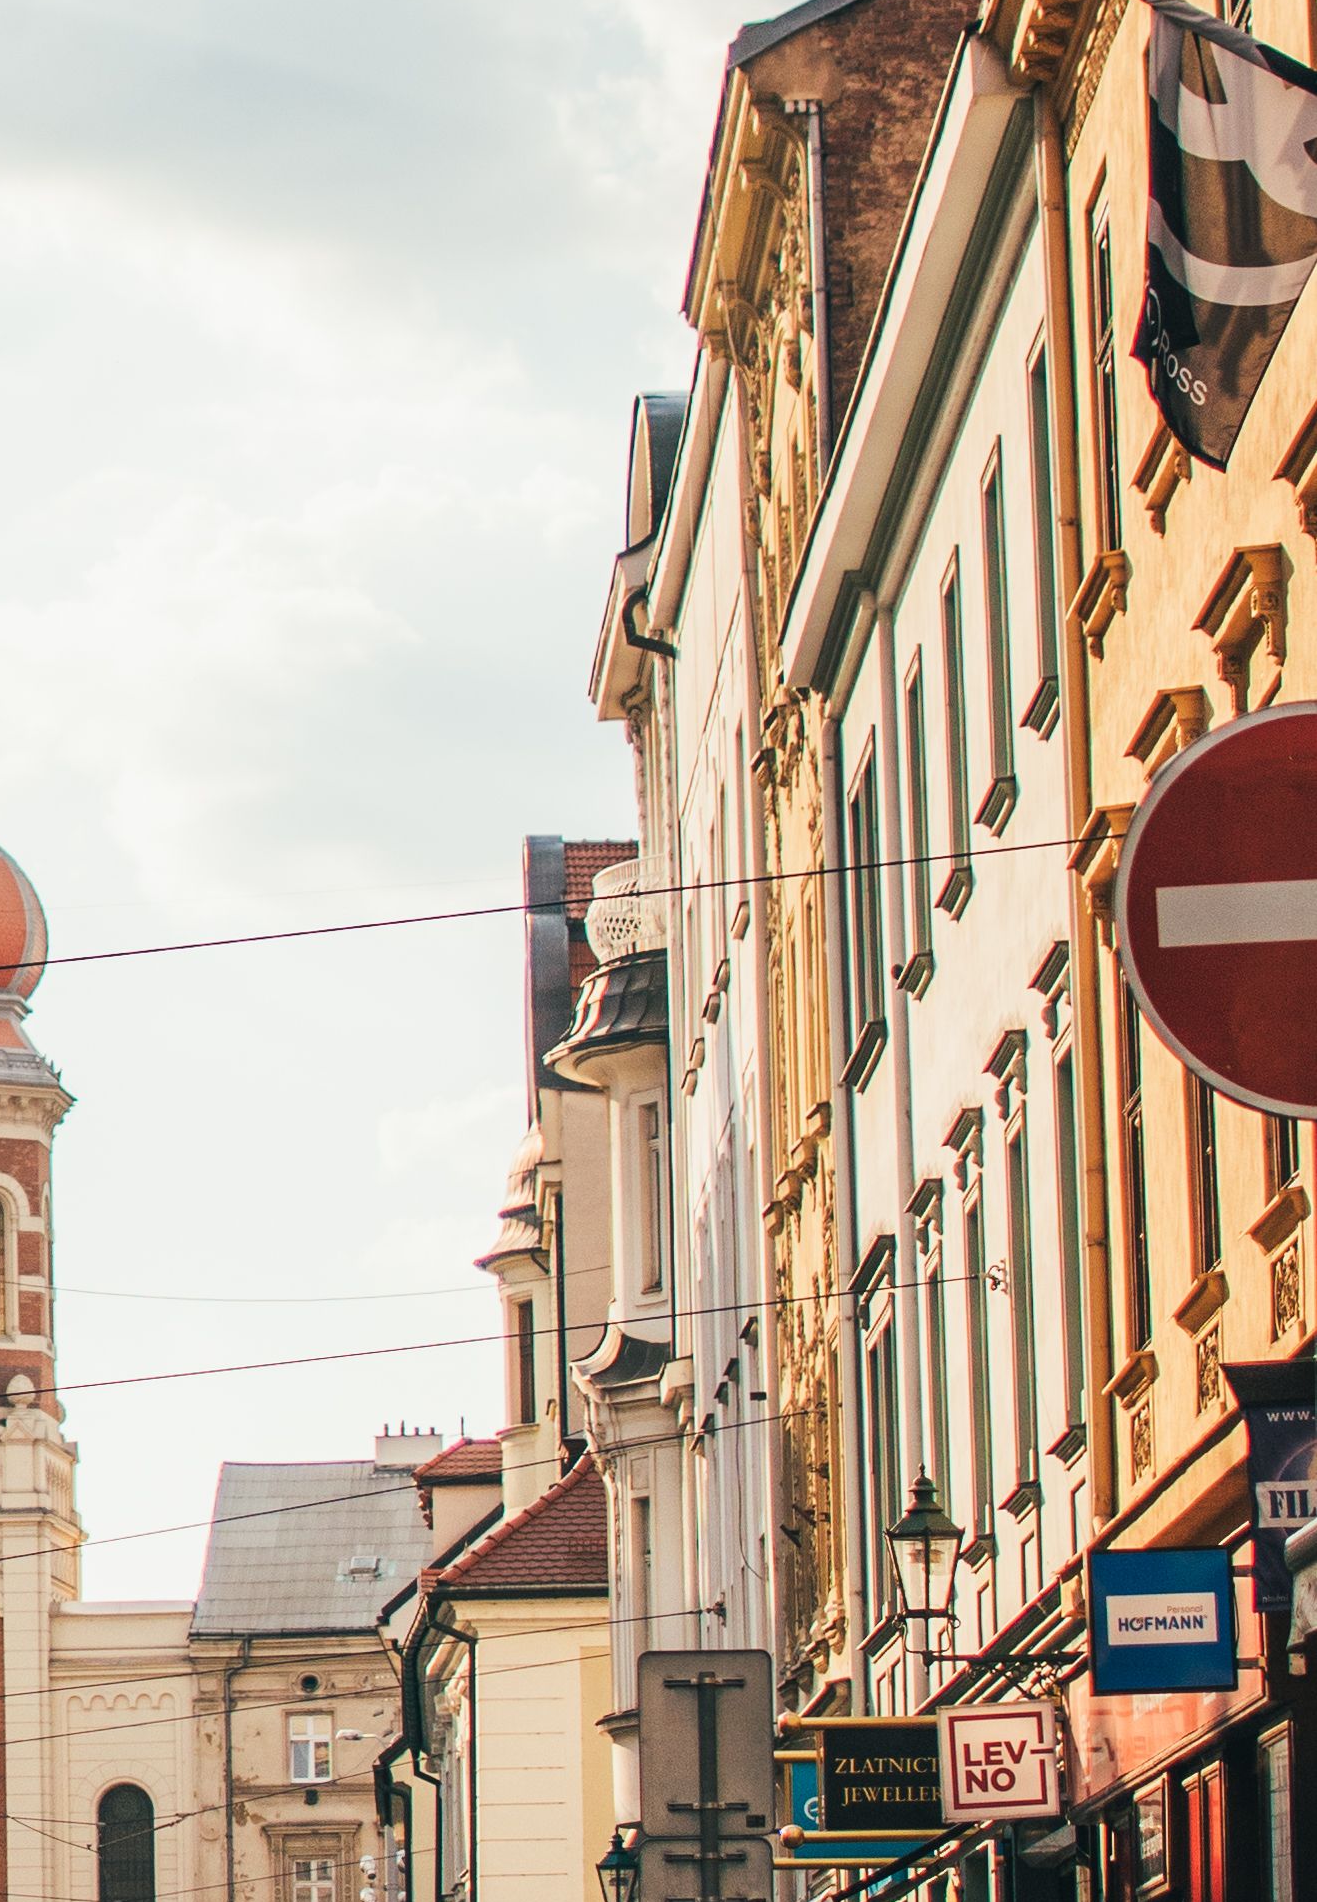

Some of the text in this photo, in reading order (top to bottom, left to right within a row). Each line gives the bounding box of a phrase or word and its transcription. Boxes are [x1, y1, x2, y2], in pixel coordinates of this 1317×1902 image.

[1167, 1605, 1203, 1614] Personal
[1118, 1615, 1204, 1632] HOFMANN
[963, 1740, 1027, 1767] LEV
[966, 1768, 1016, 1793] NO
